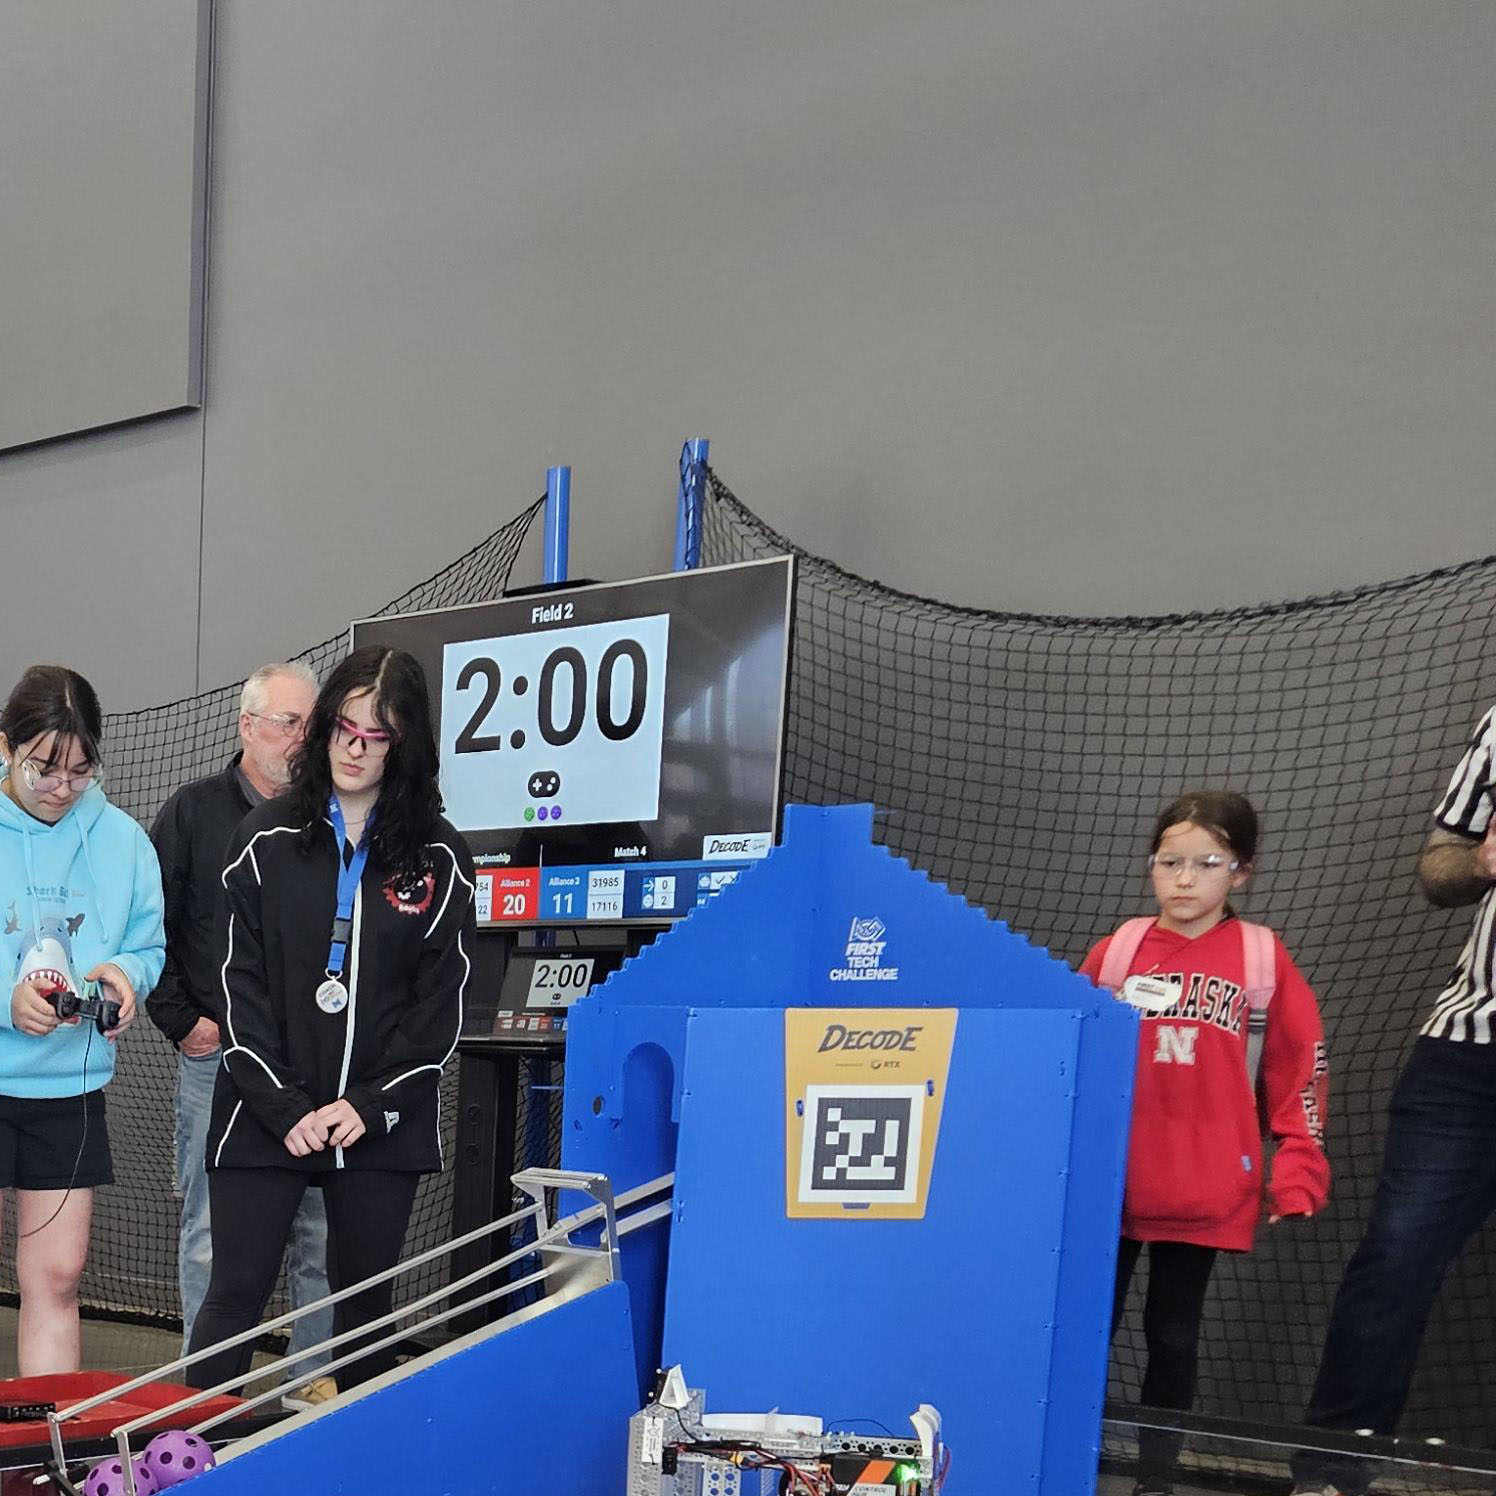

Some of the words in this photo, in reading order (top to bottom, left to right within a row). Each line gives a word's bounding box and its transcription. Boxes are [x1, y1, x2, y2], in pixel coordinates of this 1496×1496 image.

[531, 604, 562, 624] Field
[564, 602, 574, 619] 2
[454, 639, 648, 755] 2:00
[614, 847, 639, 858] Match
[641, 845, 647, 856] 4
[709, 839, 751, 854] DECODE
[472, 853, 510, 864] mpionship
[500, 878, 524, 888] Alliance
[525, 877, 531, 887] 2
[549, 877, 573, 887] Alliance
[592, 877, 619, 888] 31985
[662, 880, 667, 889] 0
[503, 894, 526, 915] 20
[553, 892, 574, 914] 11
[592, 901, 618, 912] 17116
[661, 896, 667, 905] 2
[845, 941, 887, 956] FIRST
[847, 956, 879, 968] TECH
[535, 964, 588, 988] 2:00
[830, 968, 899, 981] CHALLENGE
[817, 1024, 924, 1053] DECODE
[1153, 1024, 1199, 1065] N
